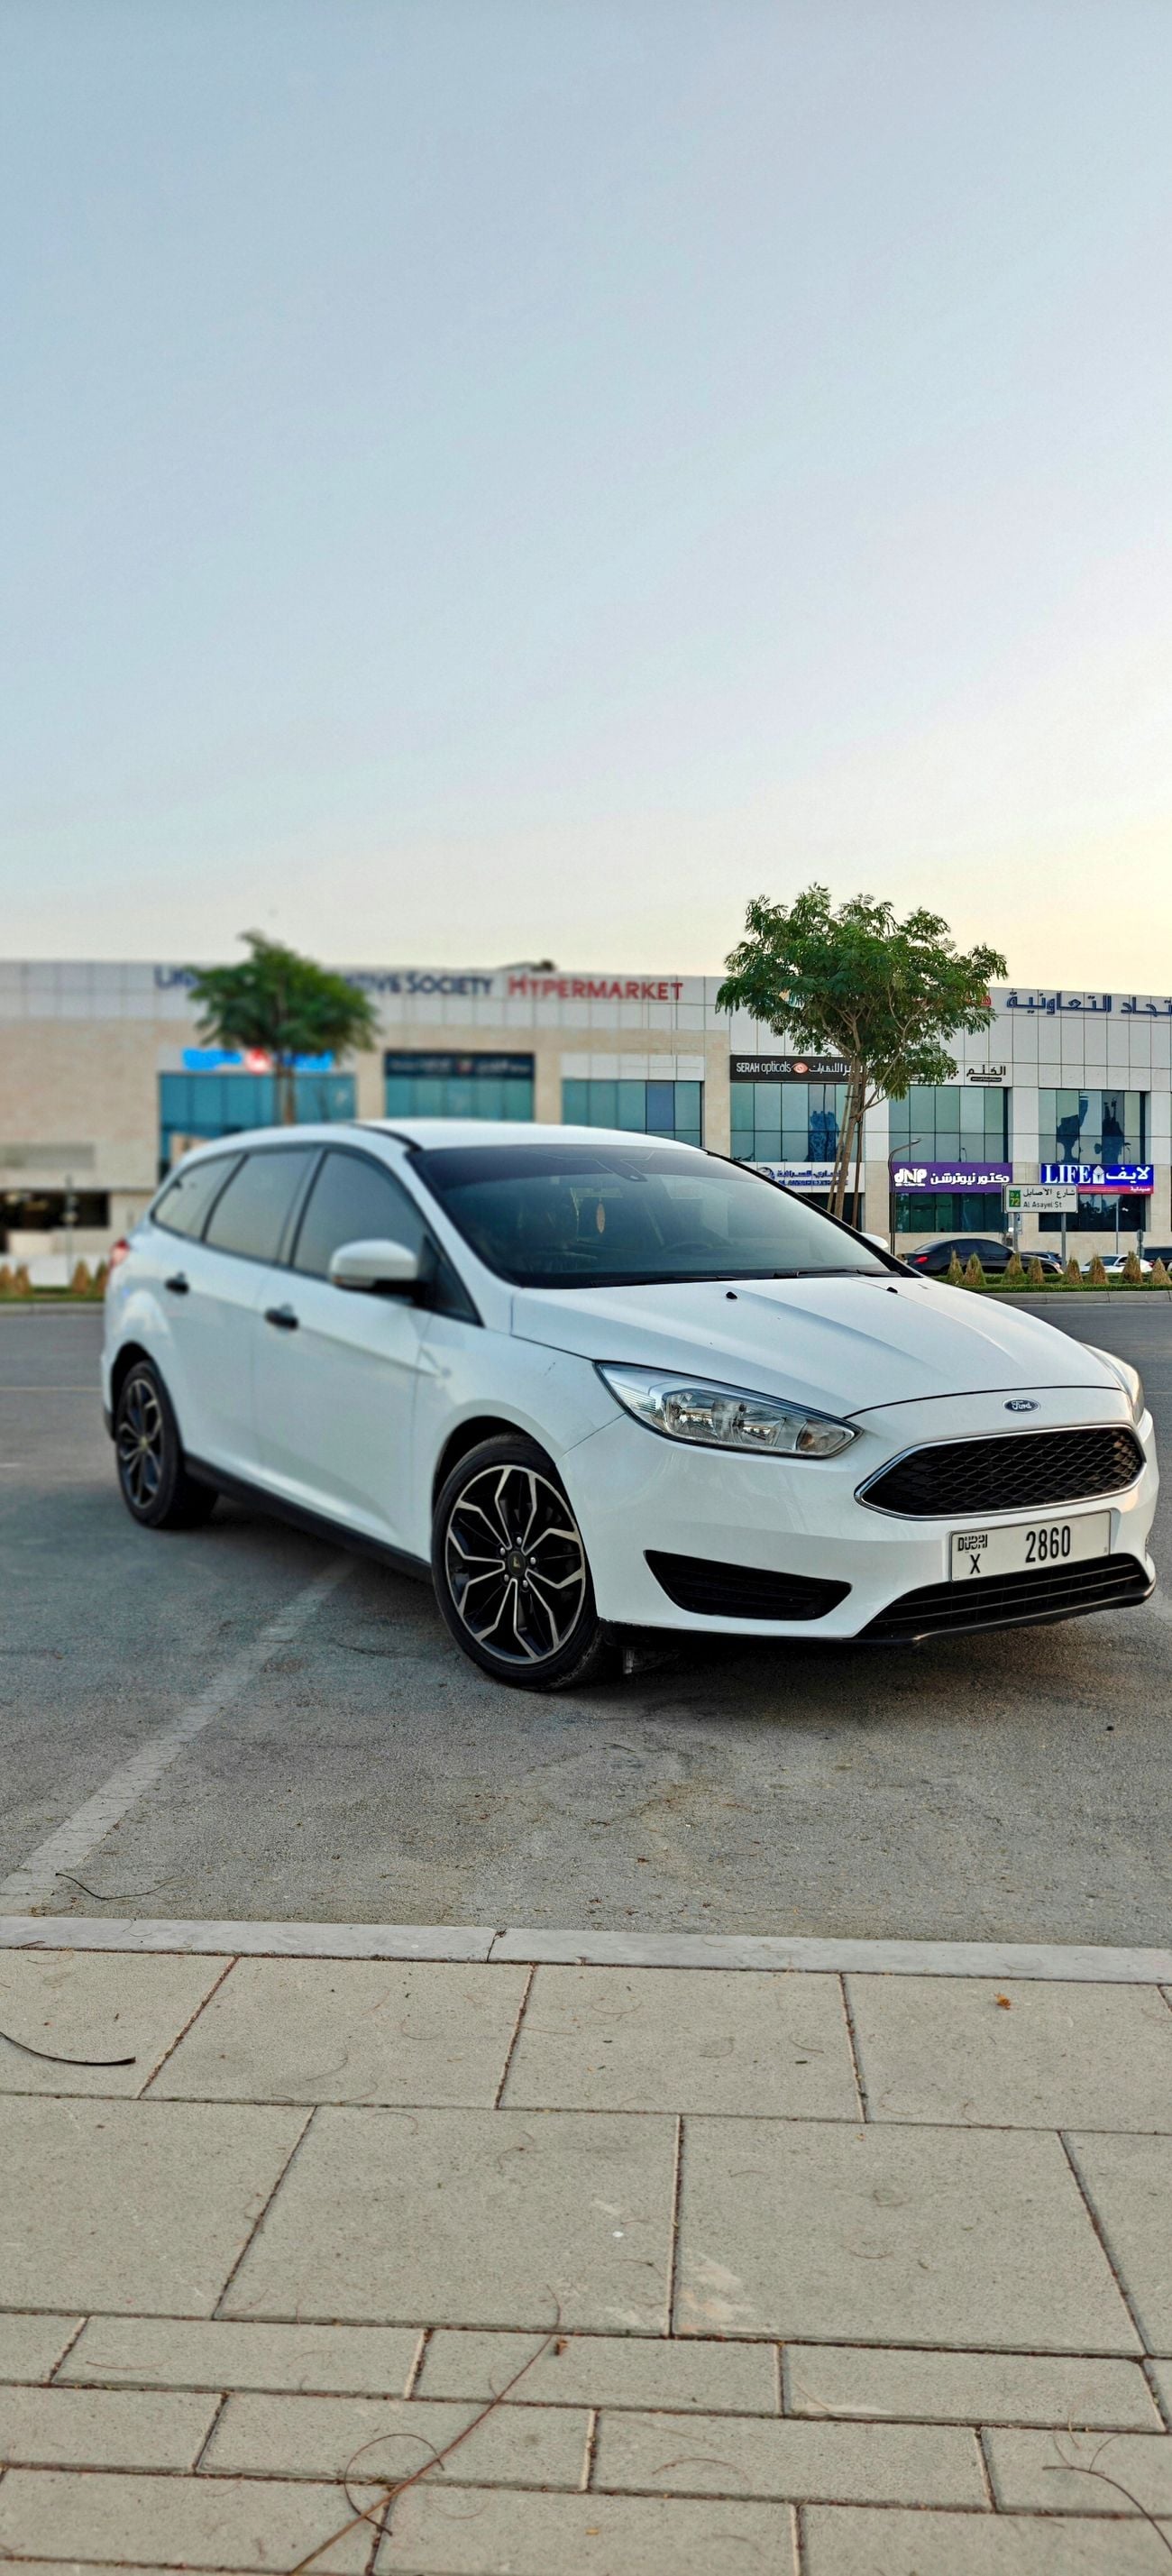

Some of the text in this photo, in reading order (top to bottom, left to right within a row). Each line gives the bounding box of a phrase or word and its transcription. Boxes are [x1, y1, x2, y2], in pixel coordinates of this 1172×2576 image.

[406, 972, 493, 995] SOCIETY
[508, 975, 683, 1001] HYPERMARKET
[1006, 992, 1112, 1015] التعاونية
[737, 1060, 792, 1075] SERAH opticals
[930, 1173, 1010, 1185] دكتور نيوترشن
[1045, 1165, 1092, 1184] LIFE
[1106, 1166, 1150, 1184] لايف
[1010, 1197, 1020, 1206] 72
[1056, 1188, 1076, 1199] شارع
[1011, 1400, 1032, 1410] Ford
[969, 1525, 1071, 1574] X 2860
